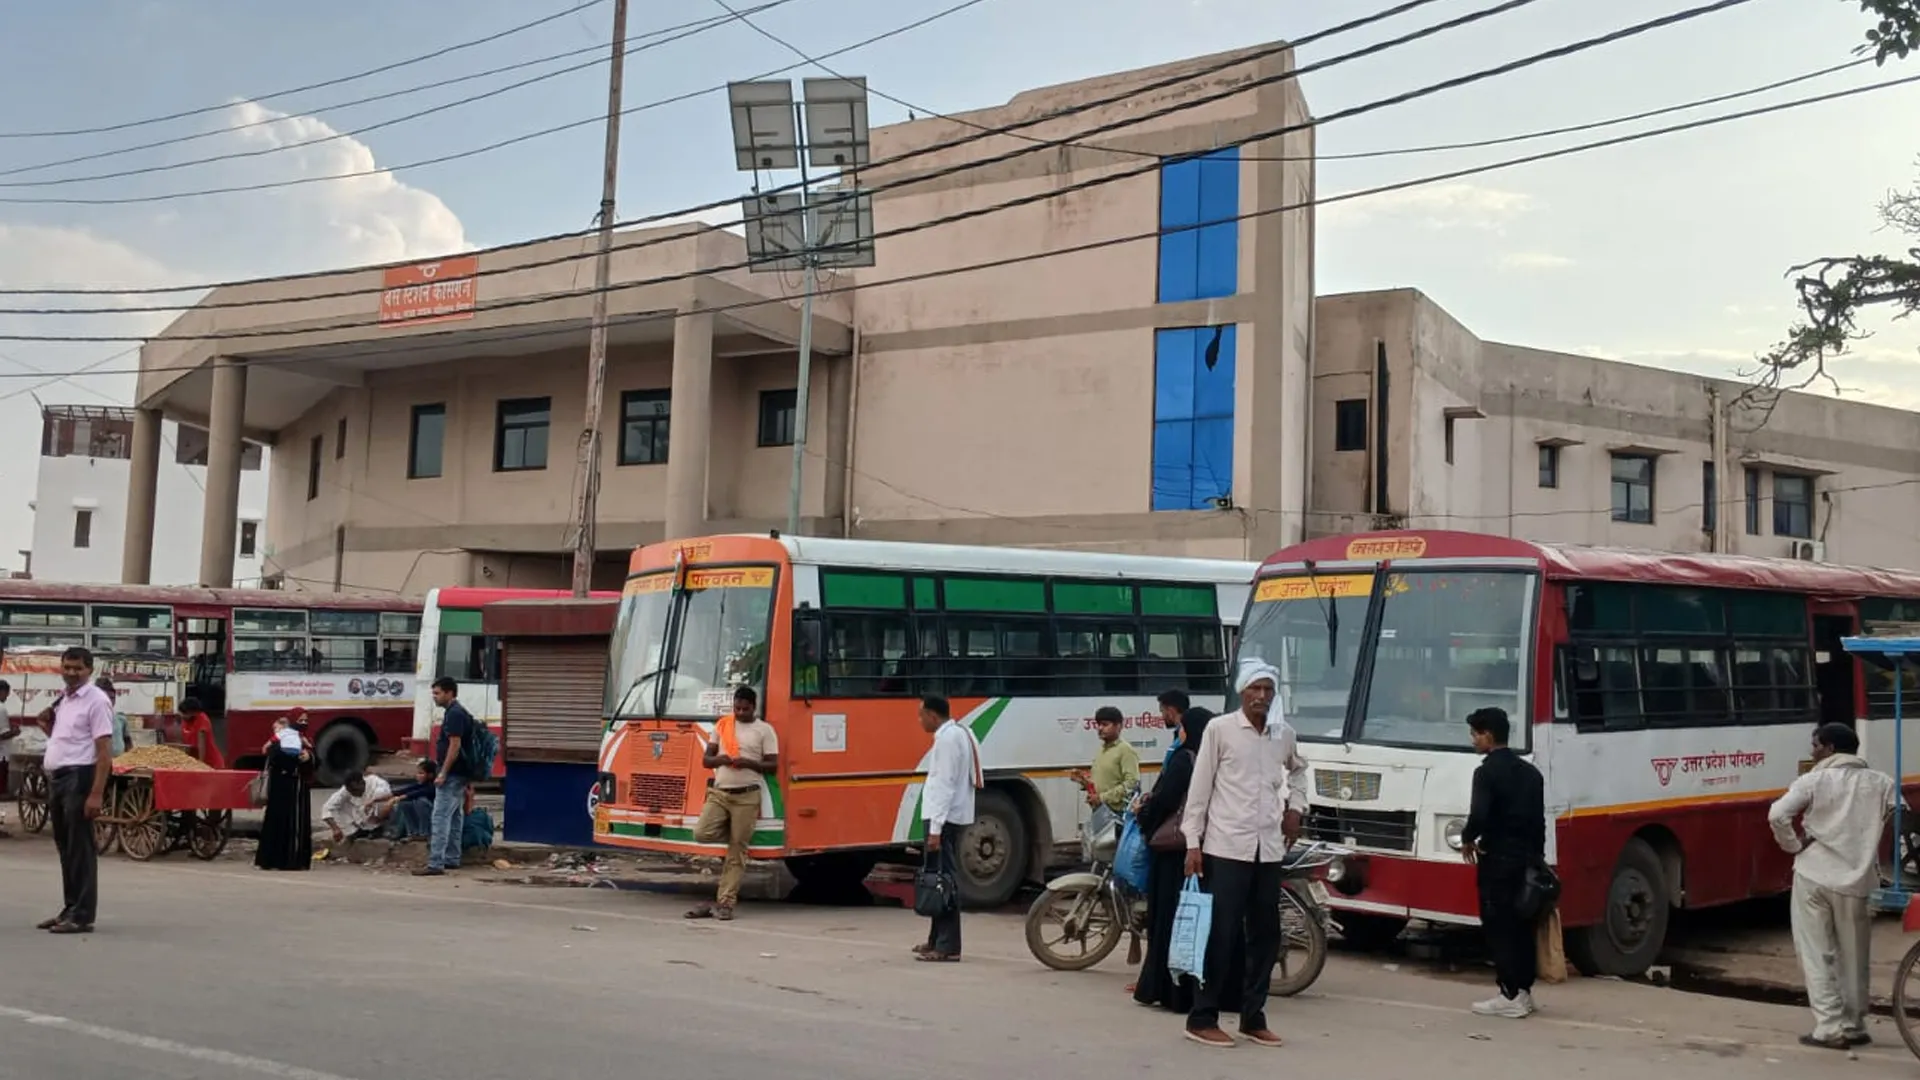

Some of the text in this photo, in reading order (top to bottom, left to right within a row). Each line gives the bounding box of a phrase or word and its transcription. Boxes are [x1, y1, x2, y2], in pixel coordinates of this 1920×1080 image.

[383, 288, 401, 308] बस
[1681, 750, 1765, 773] उत्तर प्रदेश परिवहन
